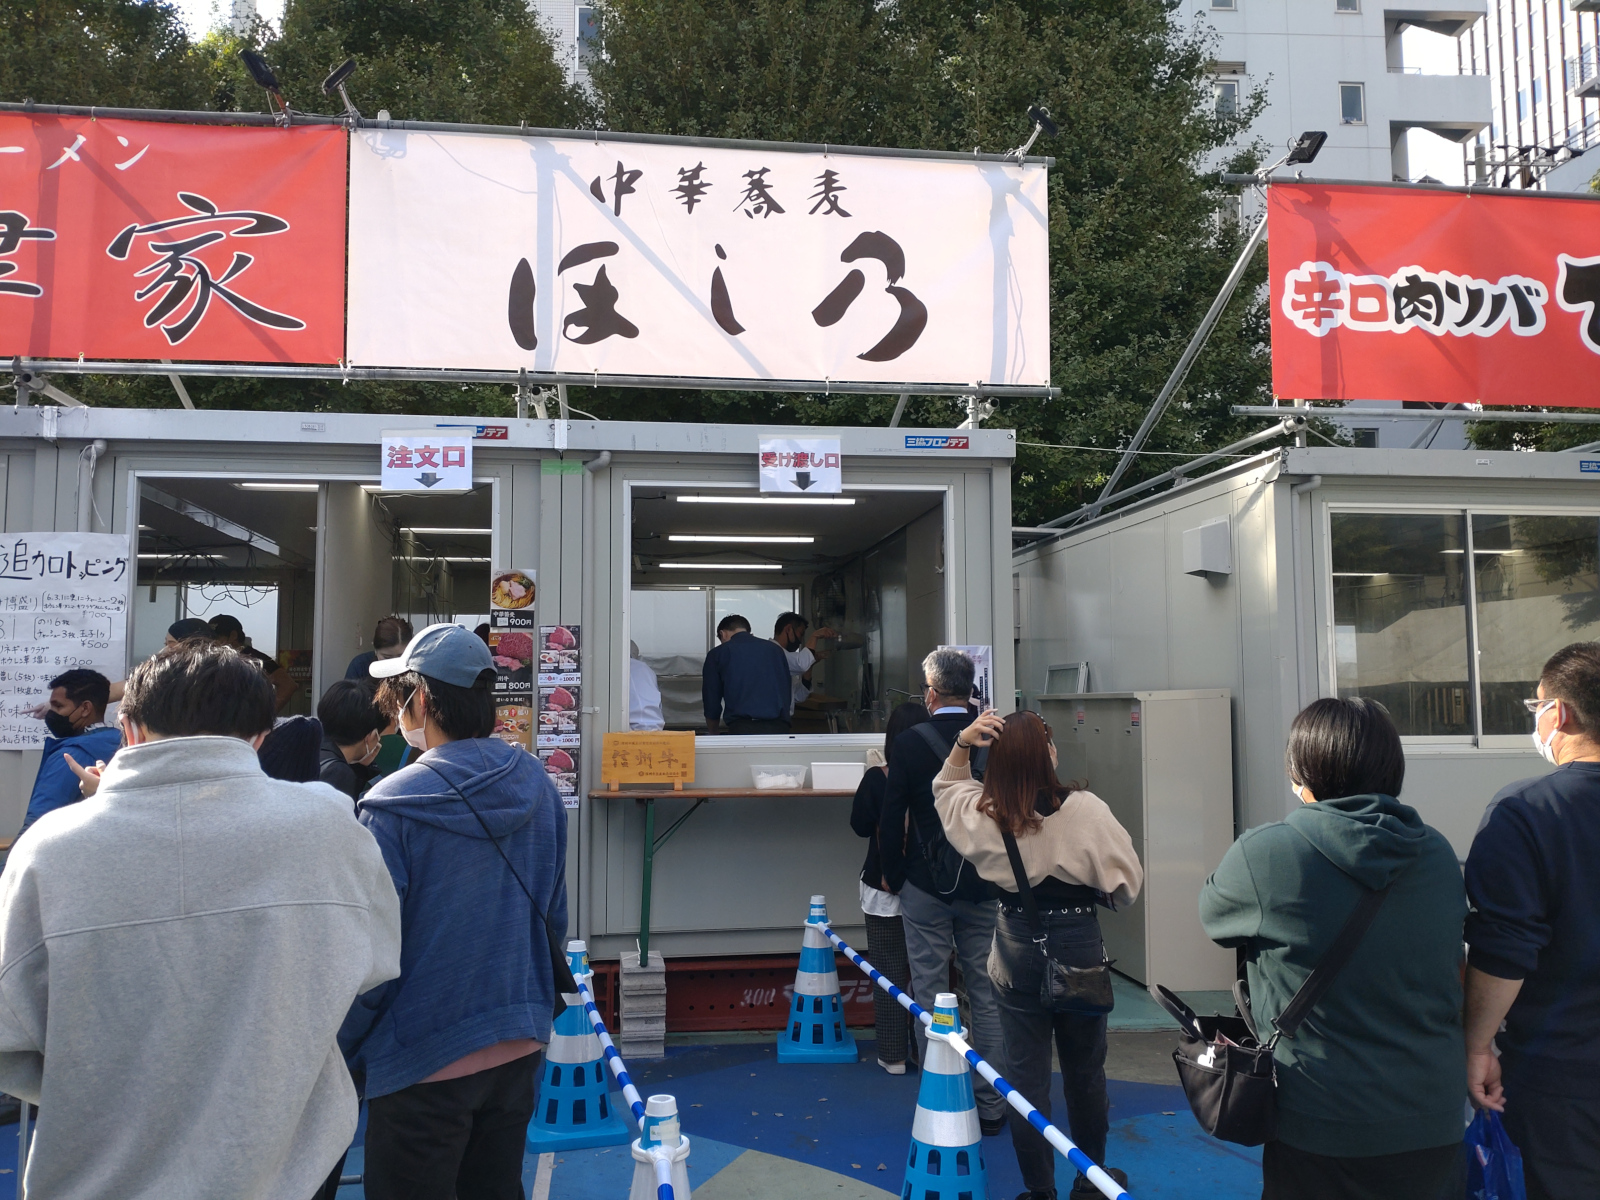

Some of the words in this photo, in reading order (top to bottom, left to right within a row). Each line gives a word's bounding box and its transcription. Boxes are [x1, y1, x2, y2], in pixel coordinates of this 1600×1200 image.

[590, 161, 853, 219] 中華蕎麦
[508, 231, 928, 362] ほし乃
[1283, 262, 1547, 336] 辛口肉ソバ
[907, 437, 968, 448] 三協フロンテア
[387, 445, 466, 468] 注文口
[761, 452, 839, 468] 受け渡し口
[0, 539, 129, 582] 追加トッピング
[509, 618, 532, 626] 900円
[80, 639, 109, 649] ¥500
[612, 749, 679, 769] 信州牛
